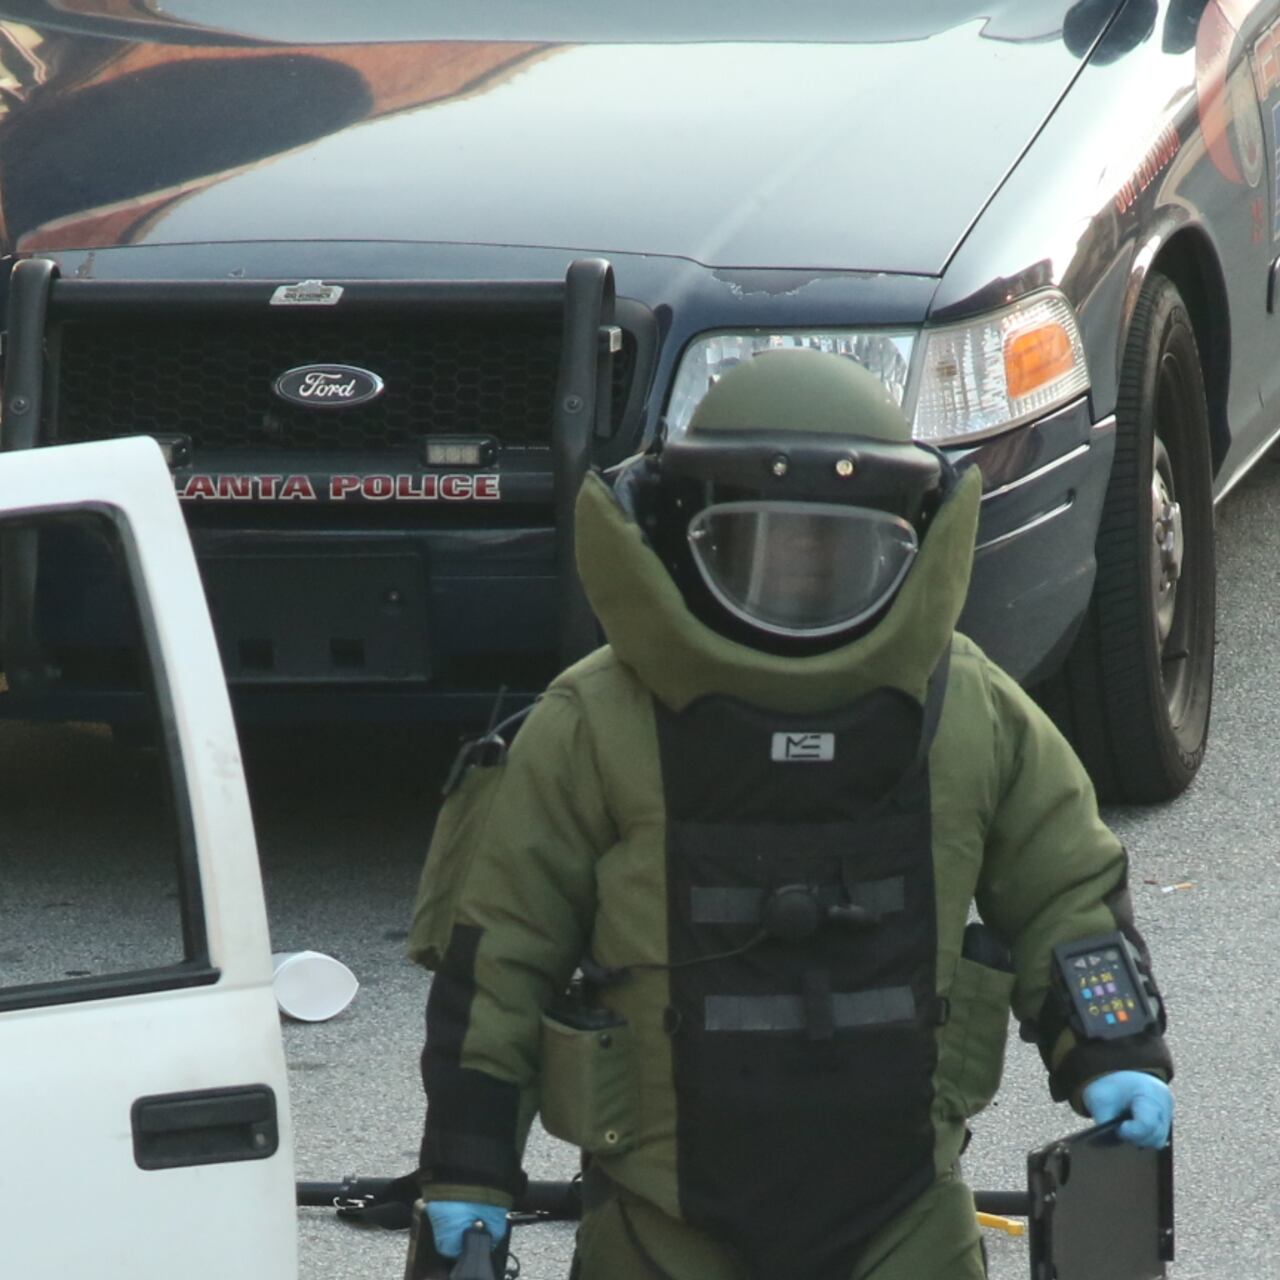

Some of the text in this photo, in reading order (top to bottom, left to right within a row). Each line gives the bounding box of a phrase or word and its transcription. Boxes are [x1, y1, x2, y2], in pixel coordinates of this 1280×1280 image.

[298, 372, 356, 398] Ford
[175, 474, 501, 500] ANTA POLICE
